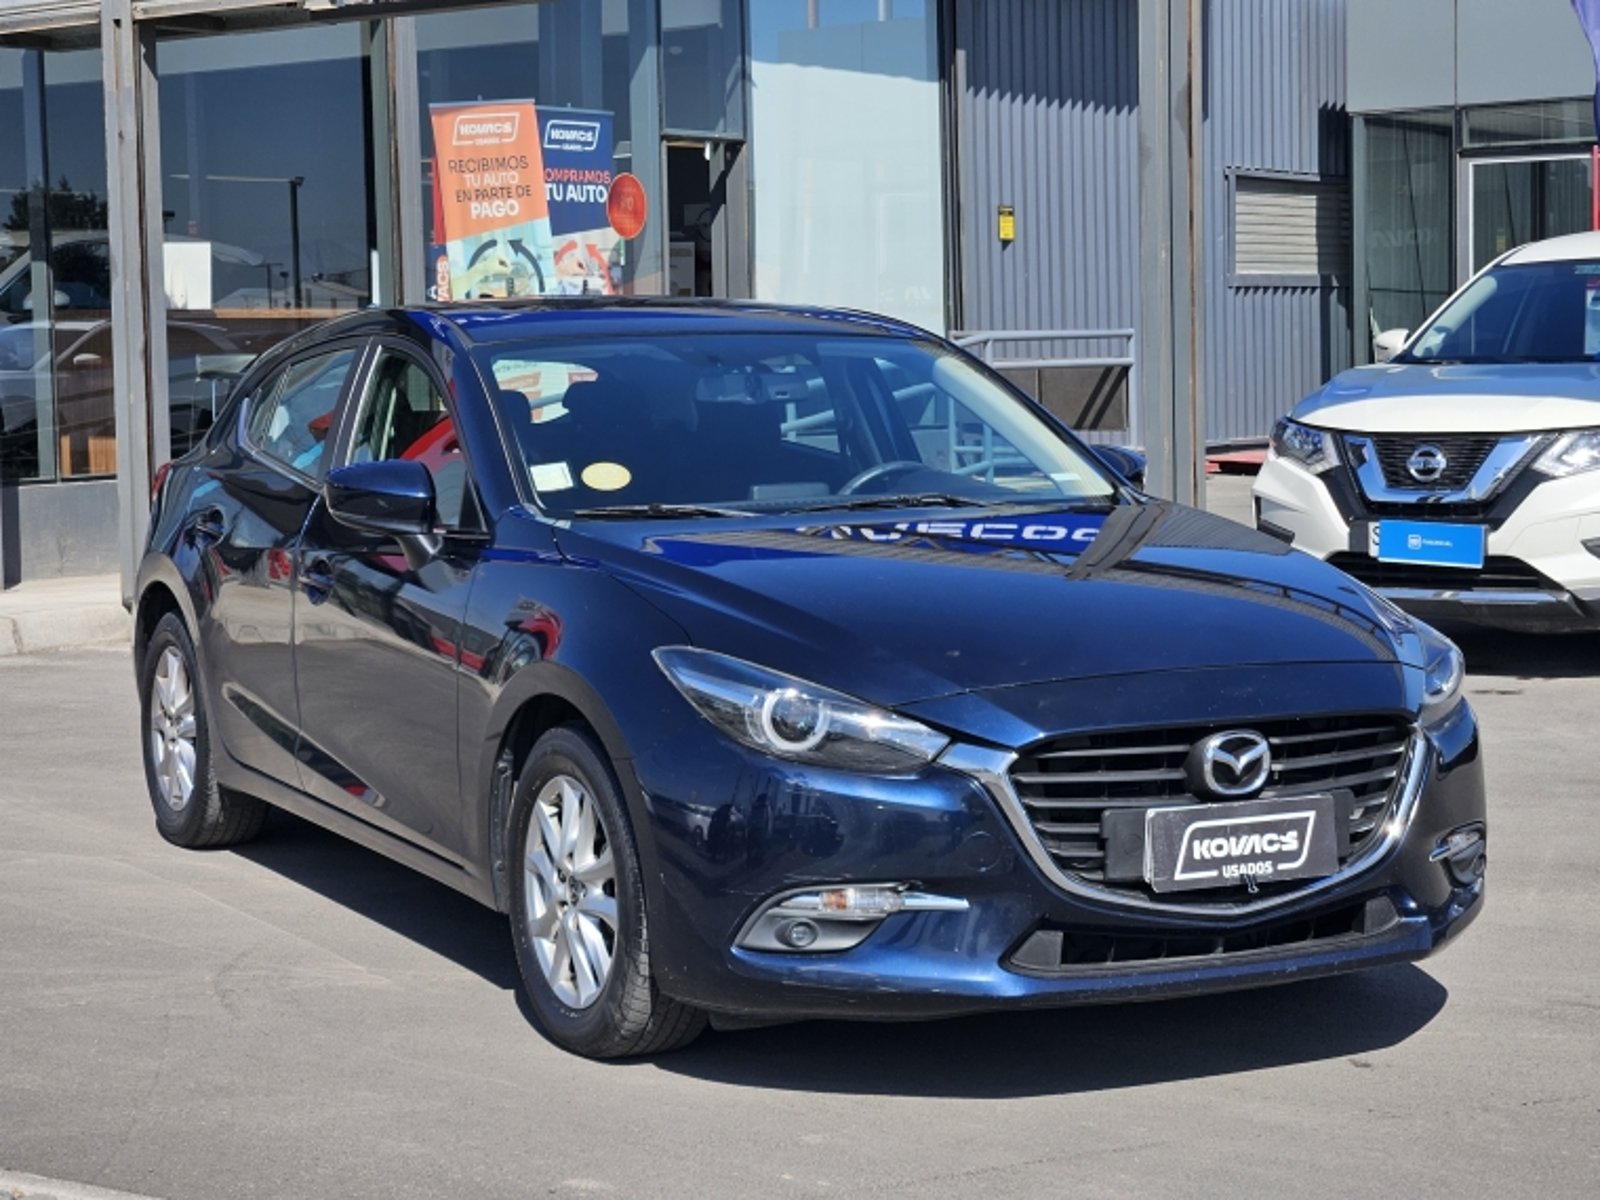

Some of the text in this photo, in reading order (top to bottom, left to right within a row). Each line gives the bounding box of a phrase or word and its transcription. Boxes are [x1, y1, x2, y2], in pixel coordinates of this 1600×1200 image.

[448, 155, 529, 174] RECIBIMOS
[464, 171, 518, 187] TU AUTO
[544, 168, 611, 184] OMPRAMOS
[456, 185, 531, 202] EN PARTE DE
[544, 183, 607, 203] TU AUTO
[471, 199, 519, 219] PAGO
[1193, 830, 1299, 860] KOVACS
[1223, 861, 1274, 878] USADOS
